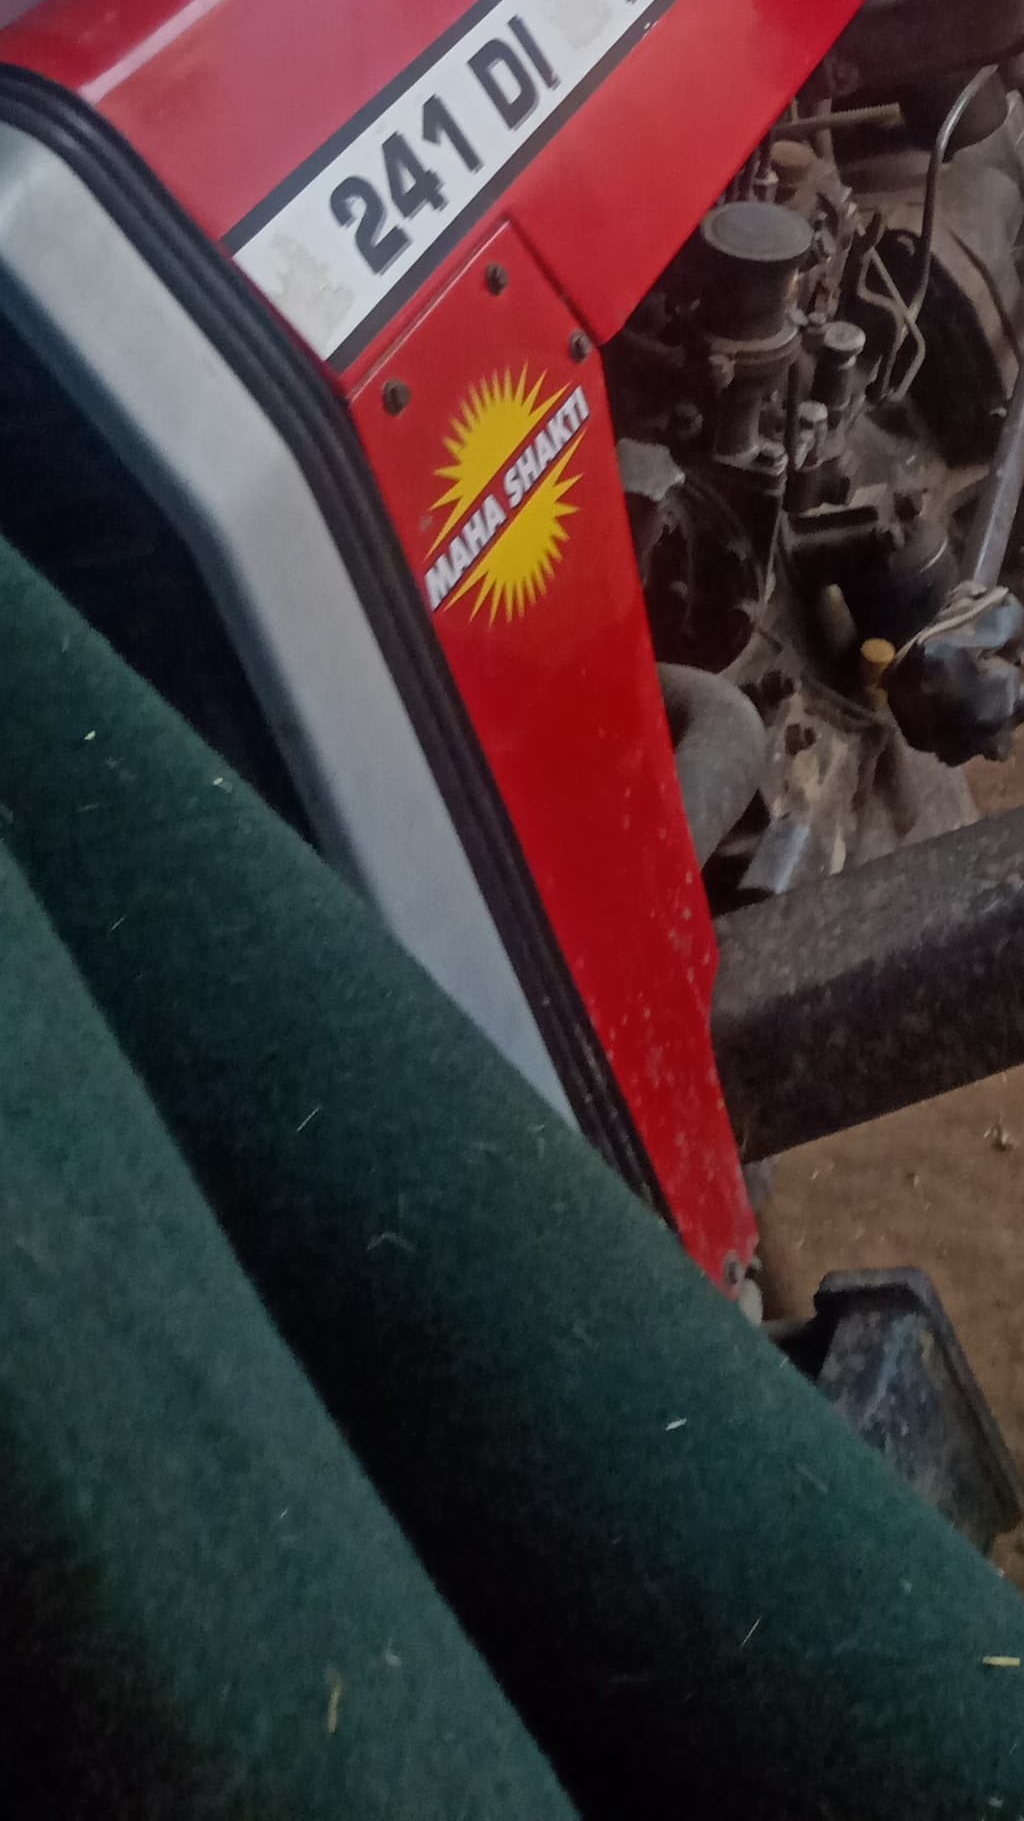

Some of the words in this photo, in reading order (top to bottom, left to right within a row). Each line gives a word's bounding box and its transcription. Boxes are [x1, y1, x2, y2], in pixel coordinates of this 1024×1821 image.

[330, 94, 484, 275] 241
[467, 14, 561, 131] DI
[424, 493, 508, 611] MAHA
[503, 385, 590, 509] SHAKTI
